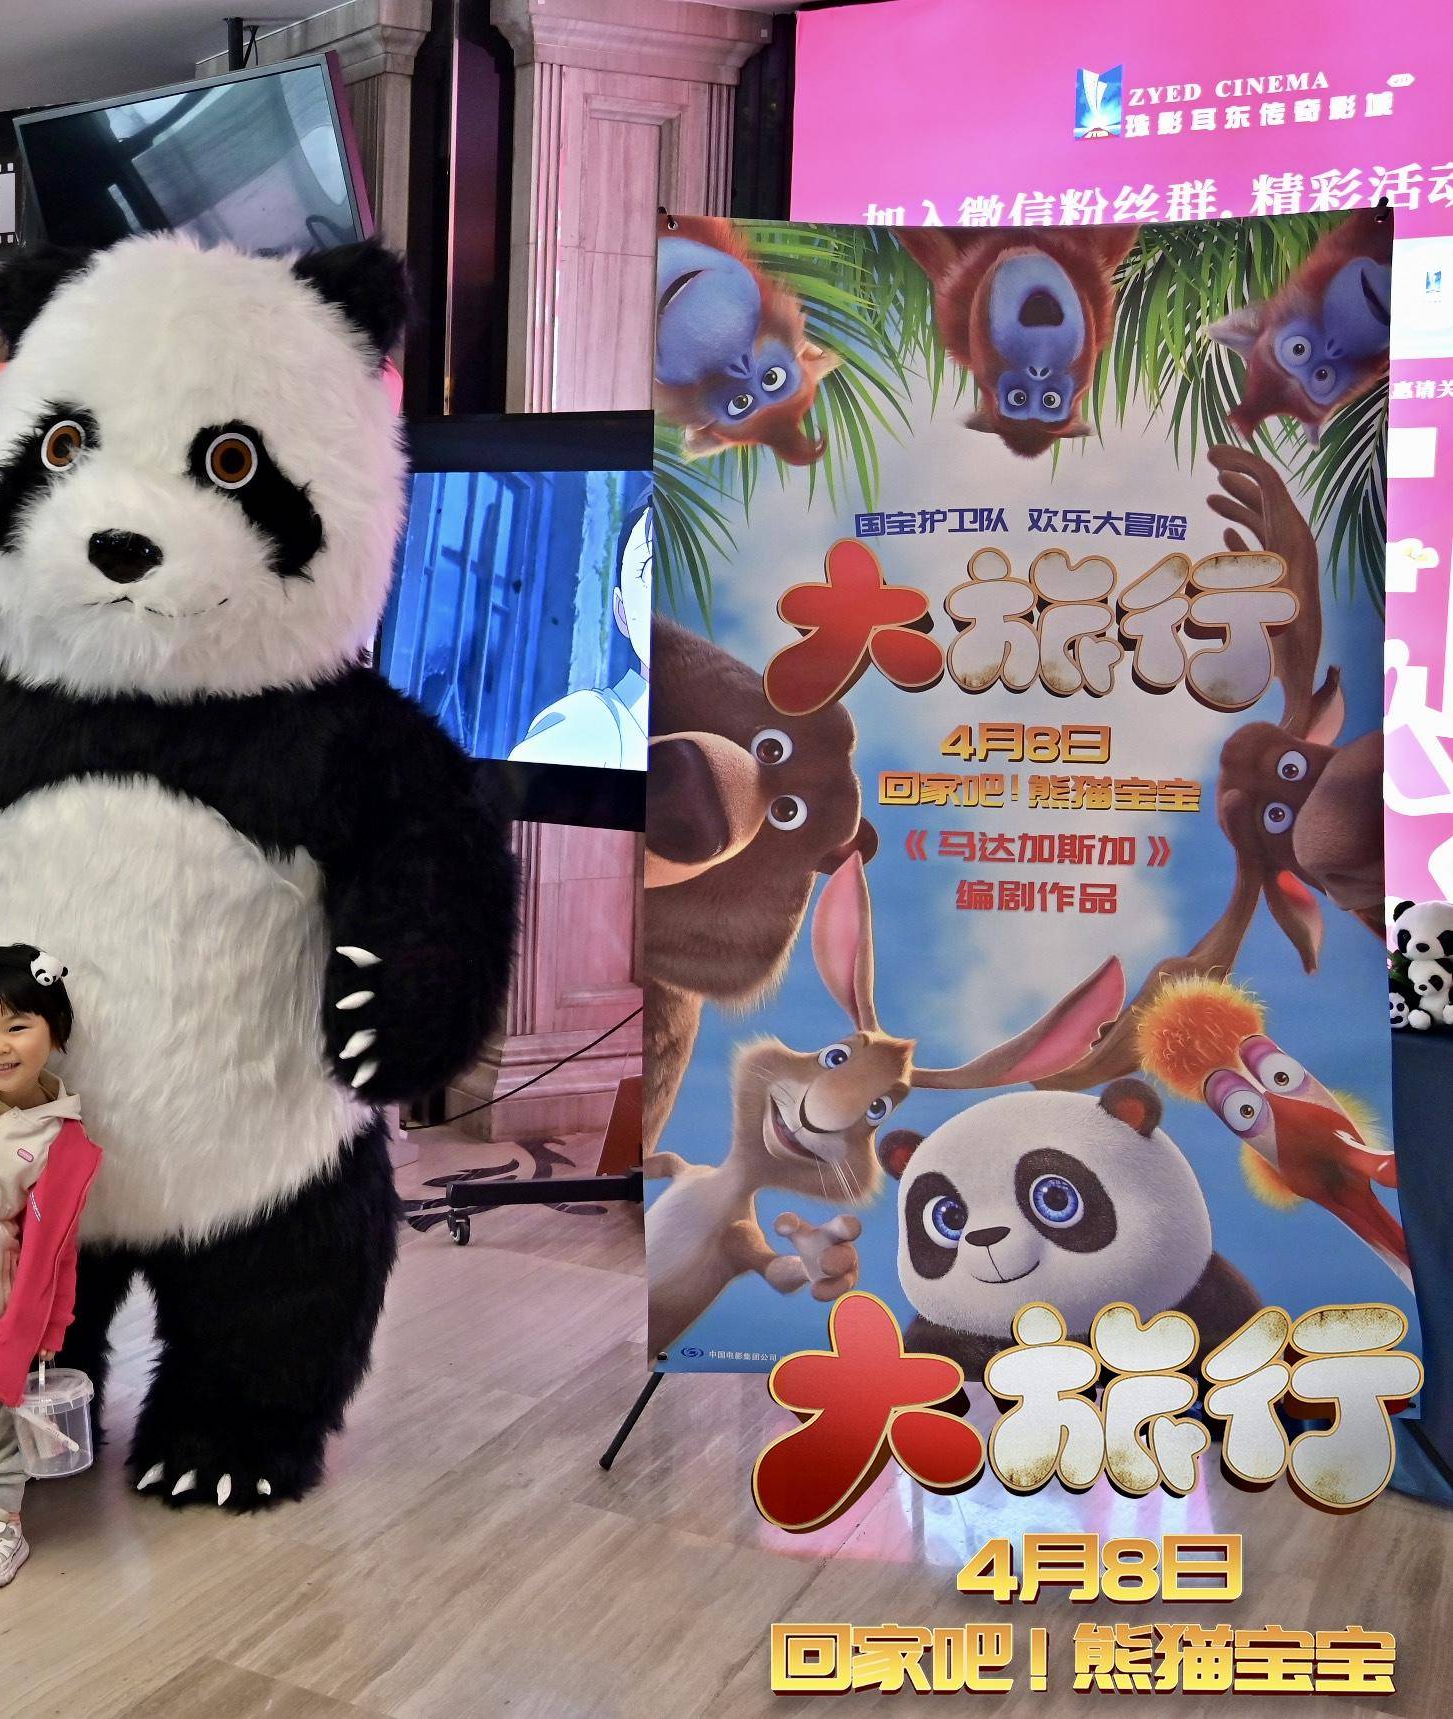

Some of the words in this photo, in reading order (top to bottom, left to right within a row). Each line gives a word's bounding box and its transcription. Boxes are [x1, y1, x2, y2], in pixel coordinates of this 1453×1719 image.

[1129, 84, 1202, 107] ZYED
[1215, 72, 1329, 98] CINEMA
[854, 507, 1010, 538] 国宝护卫队
[1027, 507, 1189, 541] 欢乐大冒险
[762, 537, 1301, 718] 大旅行
[938, 722, 1113, 766] 4月8日
[878, 769, 1203, 814] 回家吧！熊猫宝宝
[904, 828, 1172, 868] 《马达加斯加》
[954, 879, 1120, 916] 编剧作品
[708, 1349, 777, 1362] 中国电影集团公司
